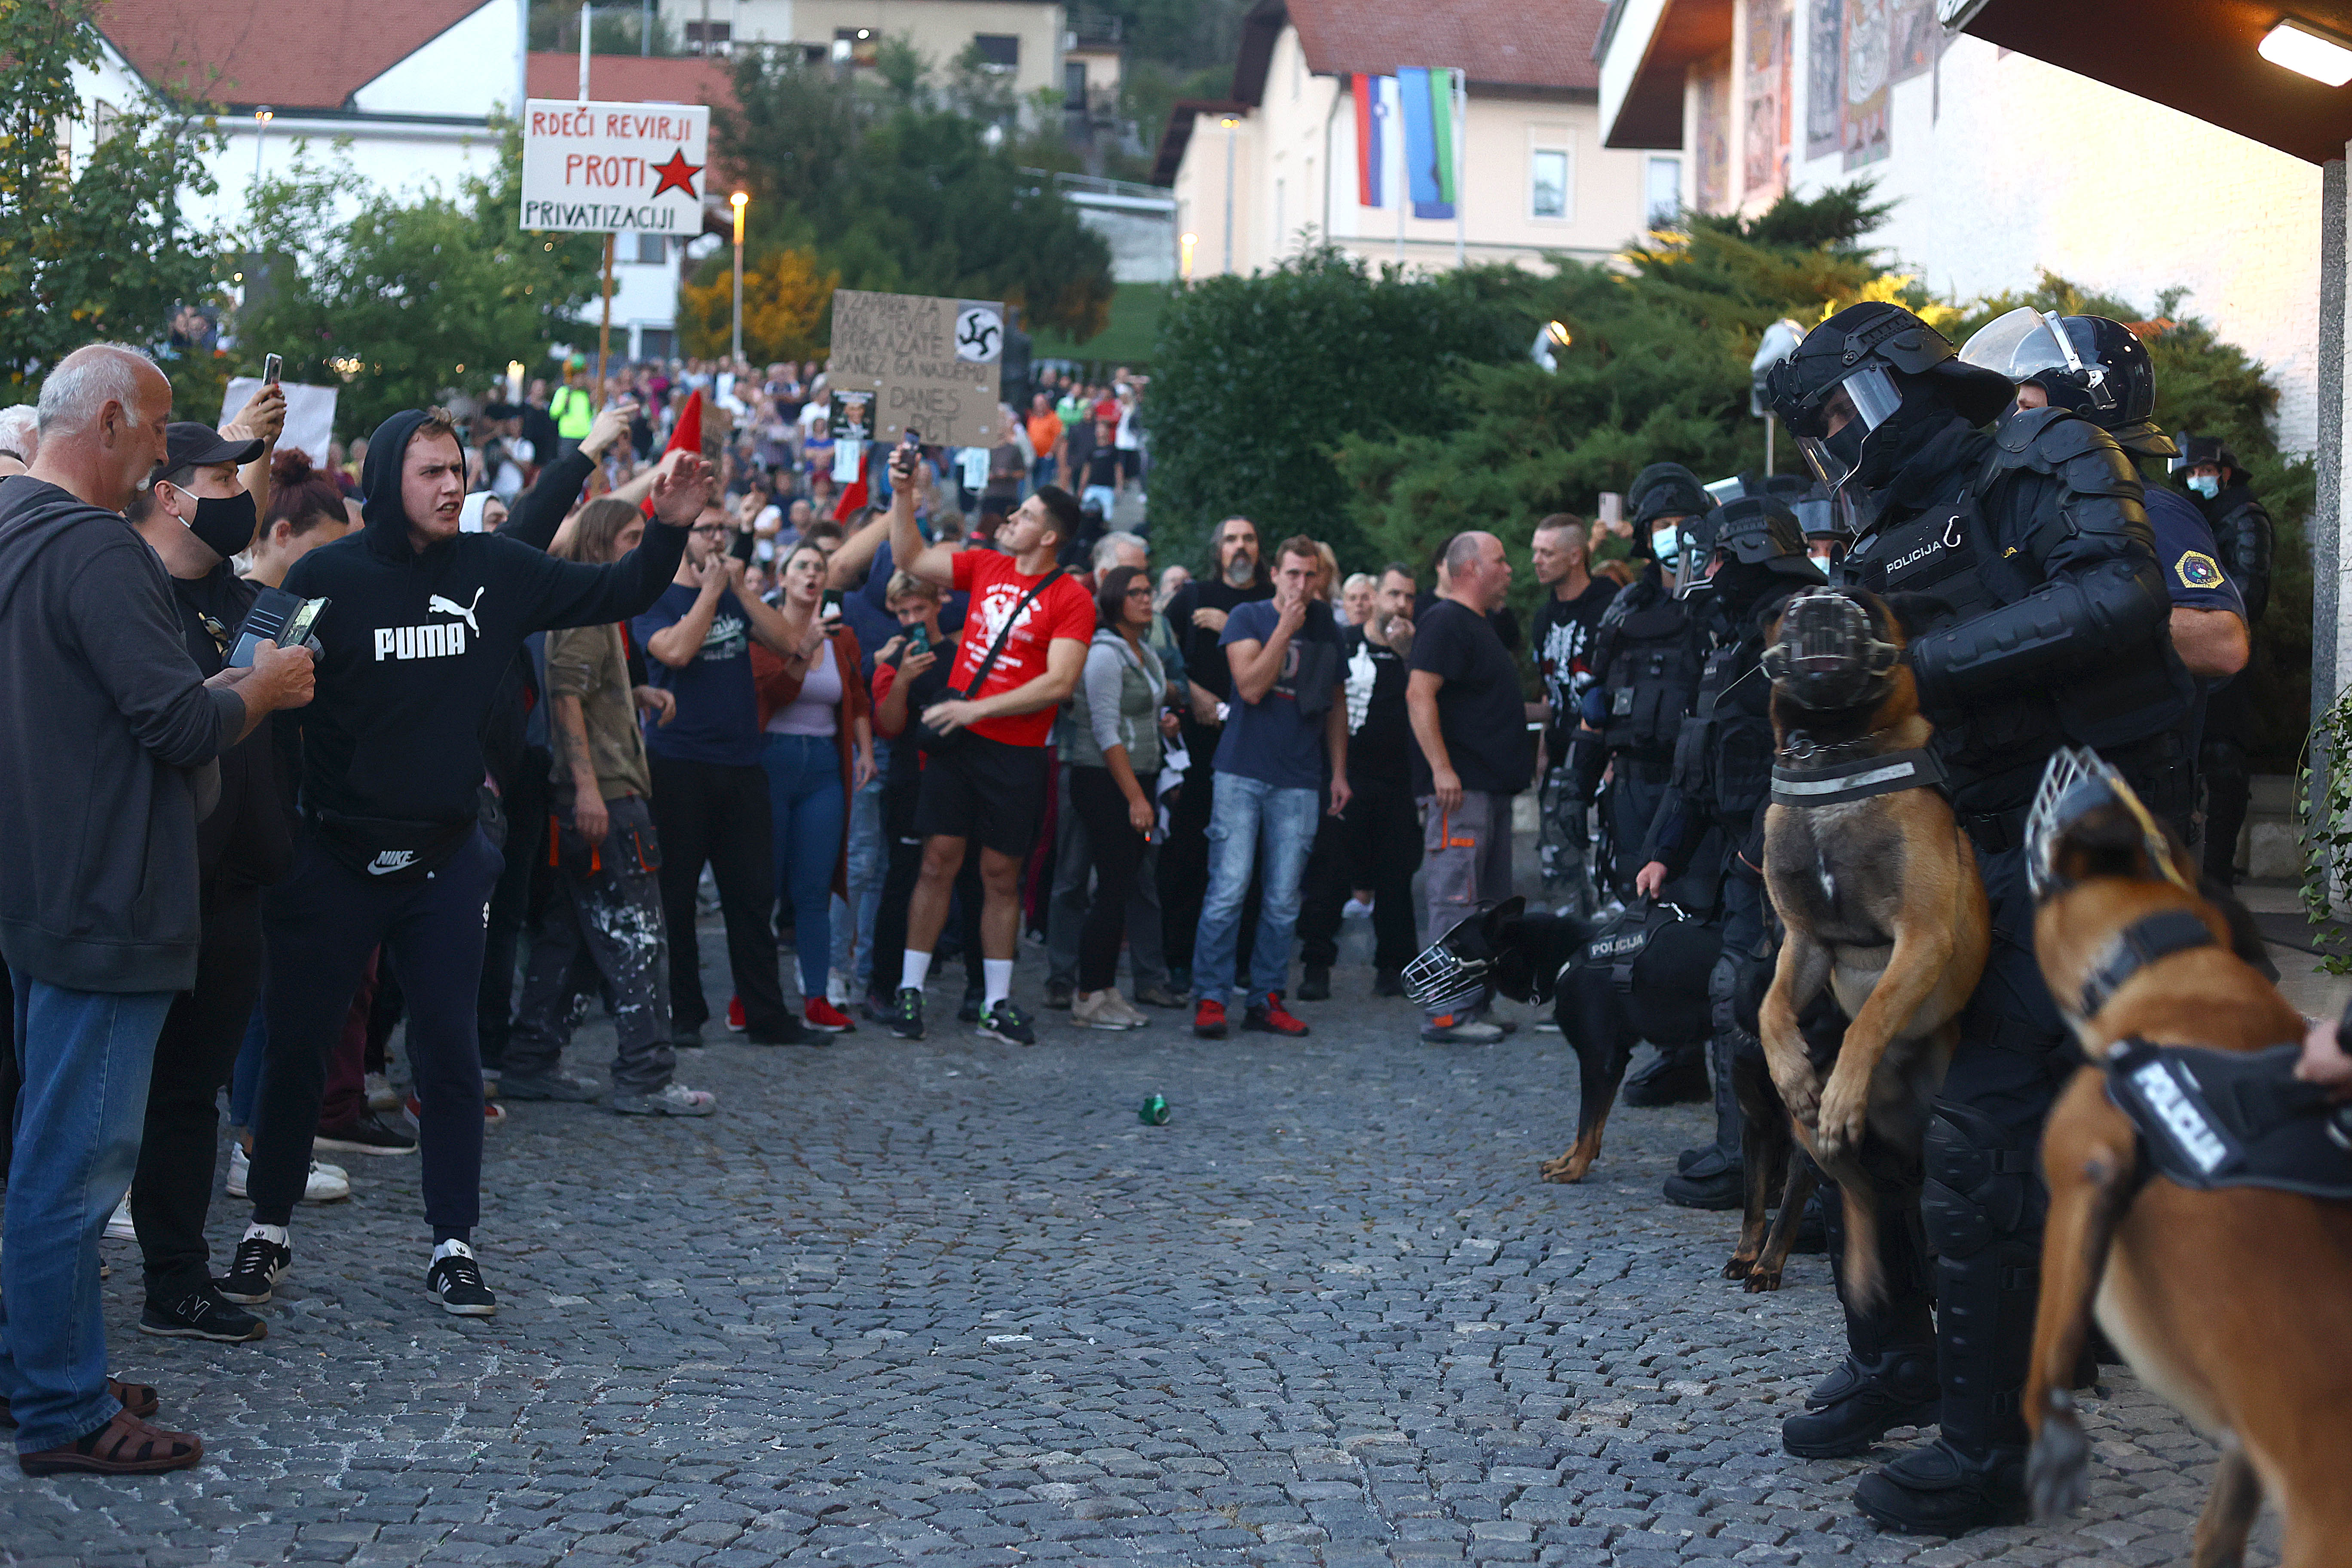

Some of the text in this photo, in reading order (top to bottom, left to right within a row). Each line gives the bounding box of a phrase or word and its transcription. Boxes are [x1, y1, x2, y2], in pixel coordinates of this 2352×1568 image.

[532, 107, 692, 141] RDEČI REVIRJI
[565, 154, 645, 187] PROTI
[525, 200, 675, 229] PRIVATIZACIJI
[889, 387, 961, 415] DANES
[1886, 541, 1942, 574] POLICIJA
[374, 622, 466, 662] PUMA
[376, 850, 414, 866] NIKE
[1592, 934, 1643, 956] POLICIJA
